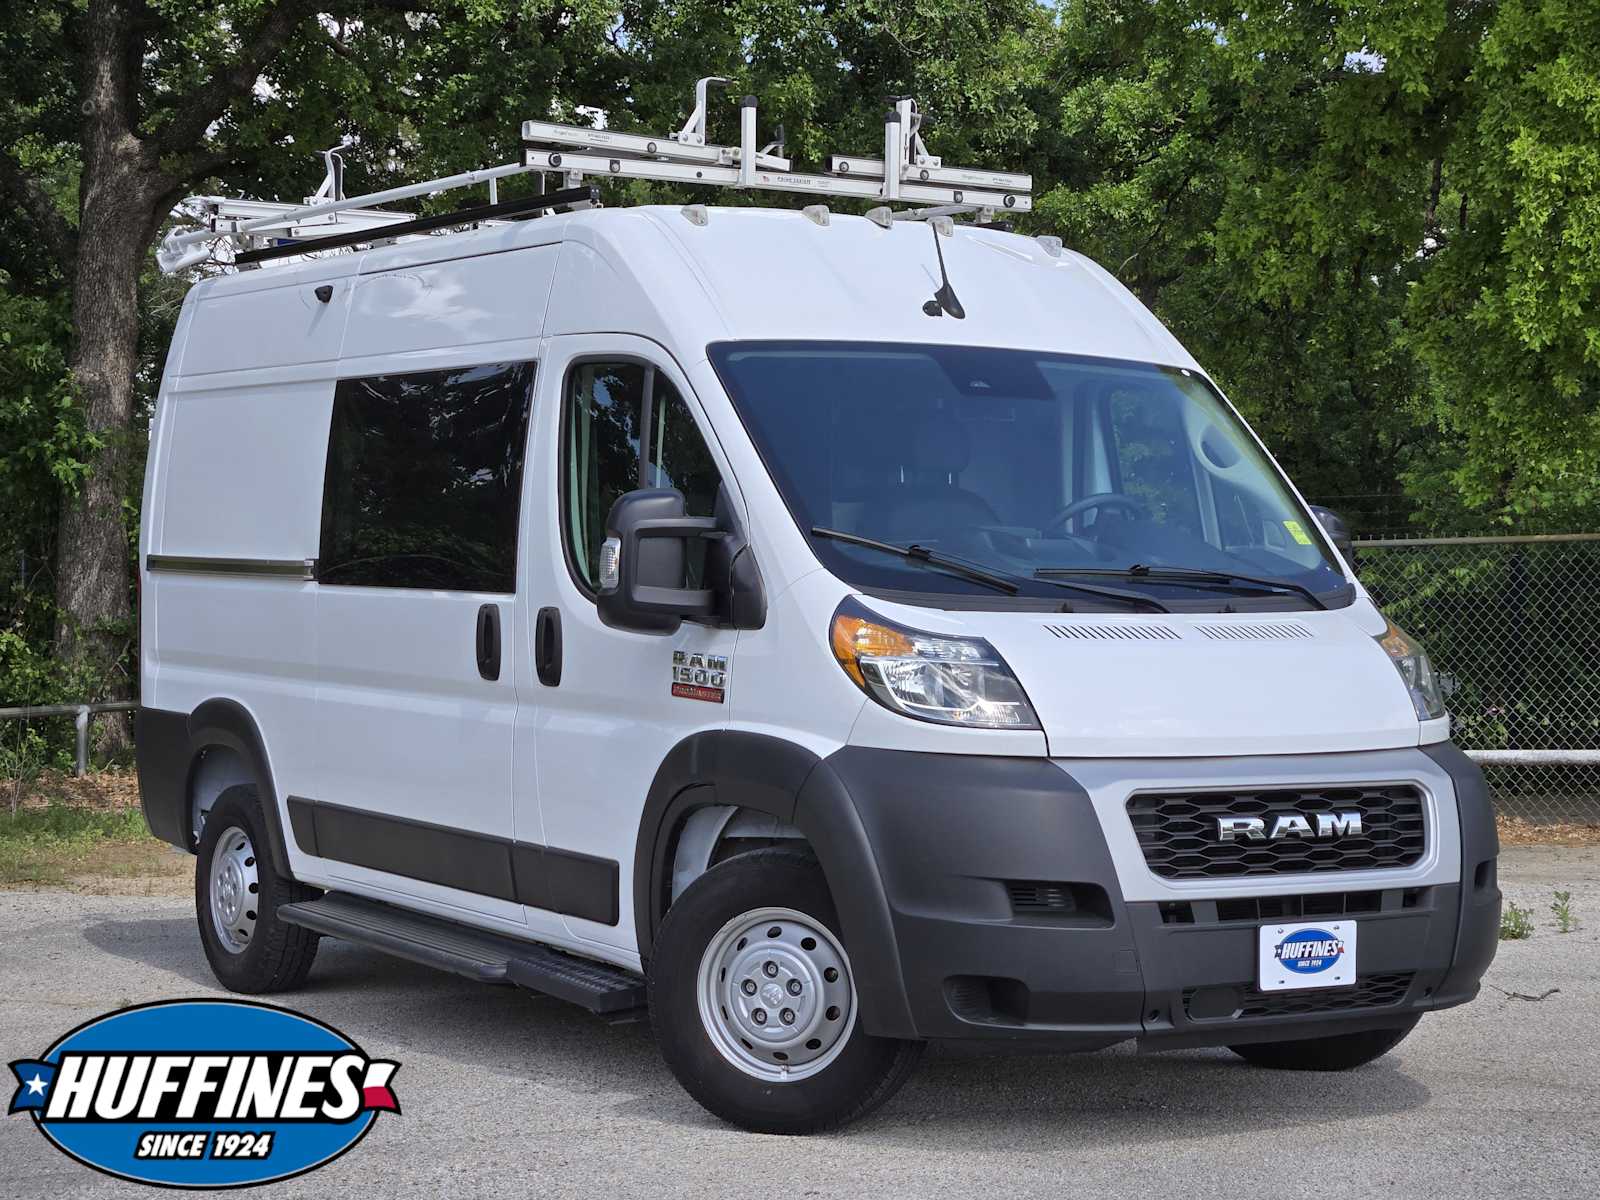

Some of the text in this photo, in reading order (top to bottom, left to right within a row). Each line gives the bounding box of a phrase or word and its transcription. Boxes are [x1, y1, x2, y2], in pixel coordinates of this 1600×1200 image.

[673, 650, 728, 671] RAM
[672, 666, 726, 688] 1500
[1217, 811, 1363, 842] RAM
[1280, 940, 1338, 959] HUFFINES
